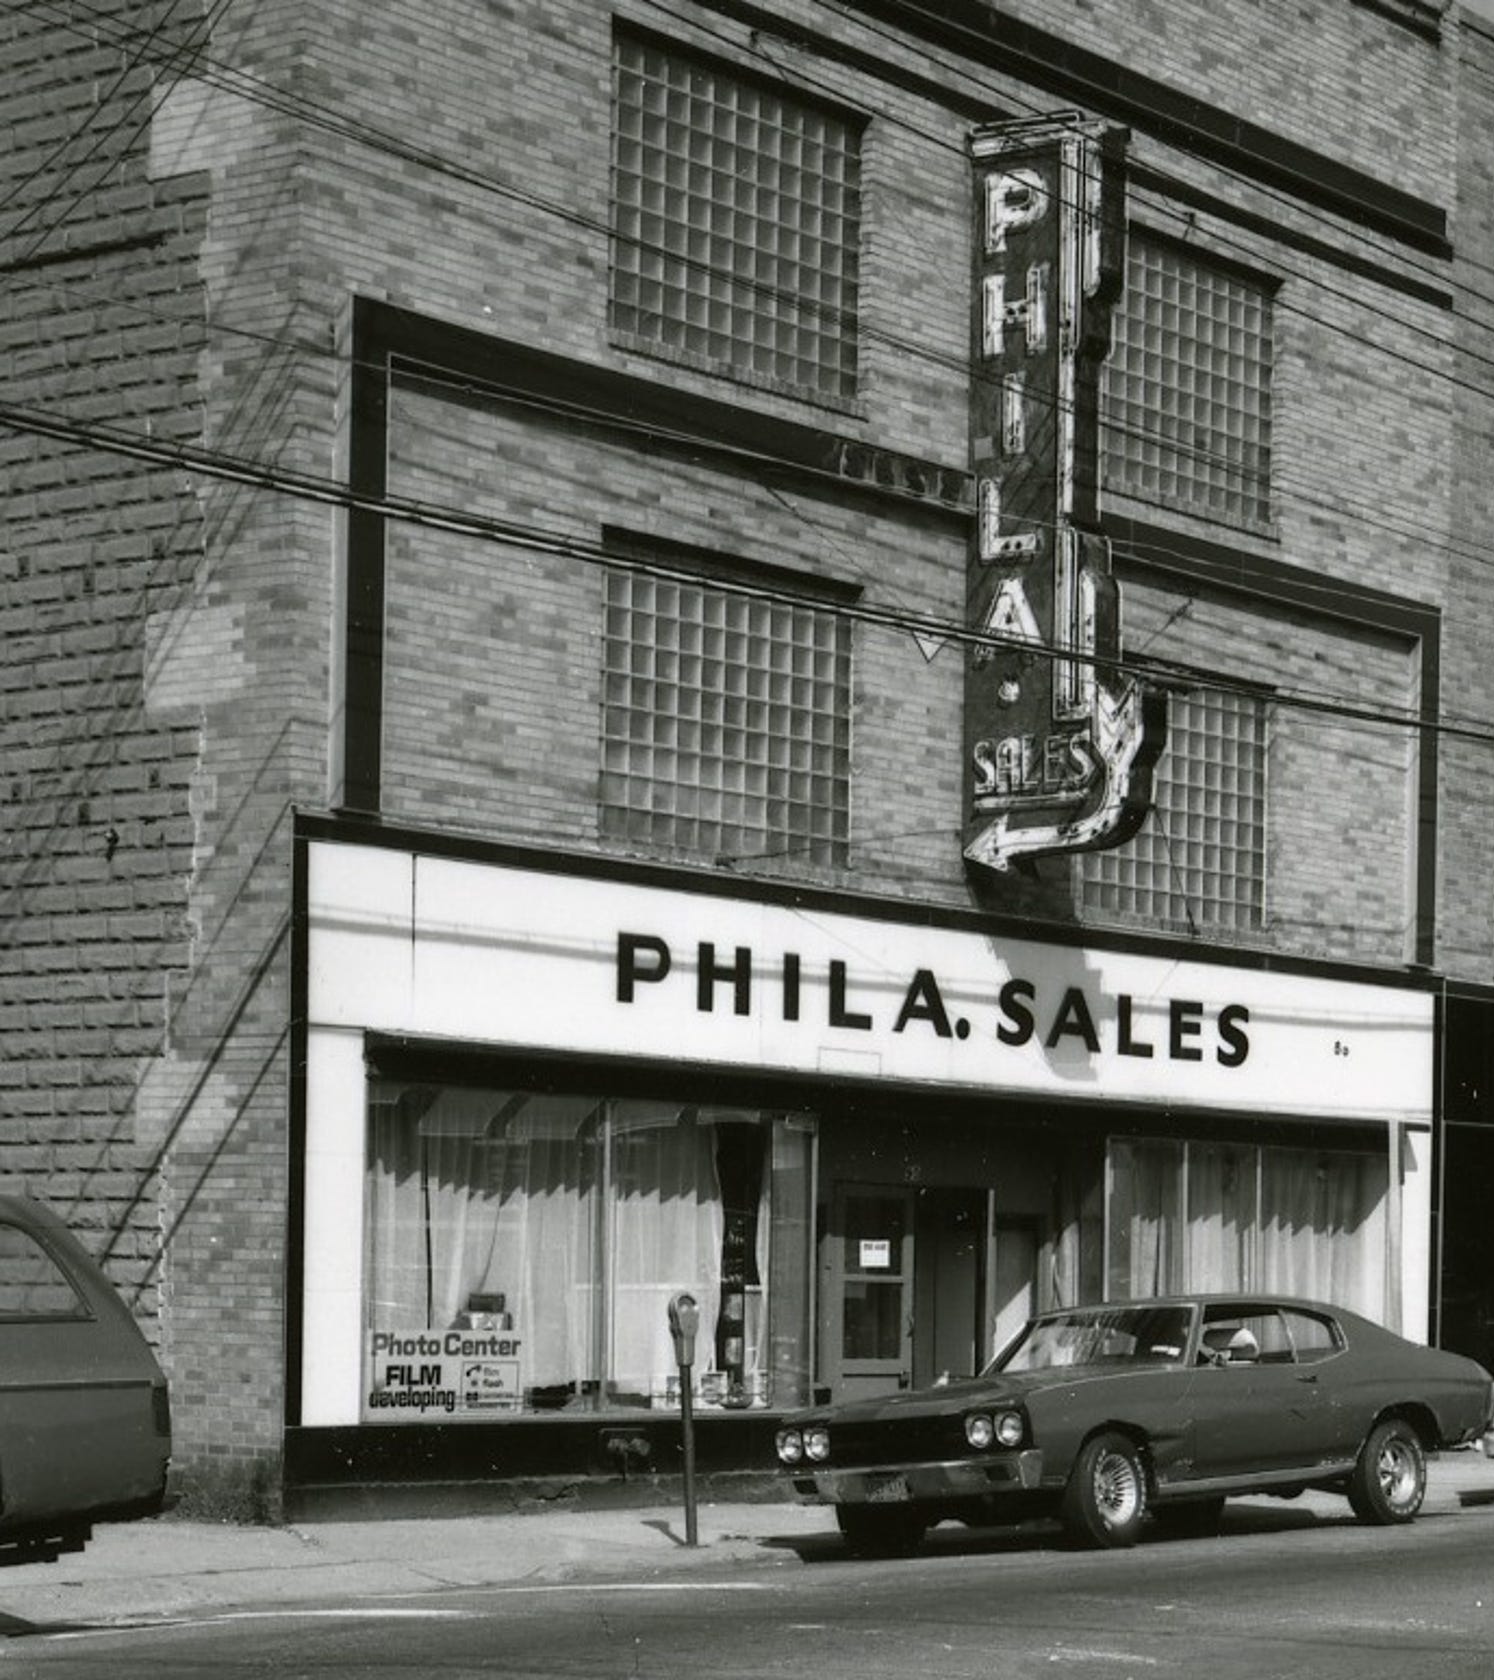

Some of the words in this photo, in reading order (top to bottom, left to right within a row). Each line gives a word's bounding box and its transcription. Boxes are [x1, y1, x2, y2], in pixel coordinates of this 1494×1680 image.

[974, 730, 1096, 796] SALES
[617, 932, 970, 1040] PHILA.
[997, 979, 1251, 1067] SALES
[372, 1333, 442, 1357] Photo
[443, 1333, 522, 1357] Center
[386, 1365, 442, 1387] FILM
[369, 1385, 456, 1413] developing
